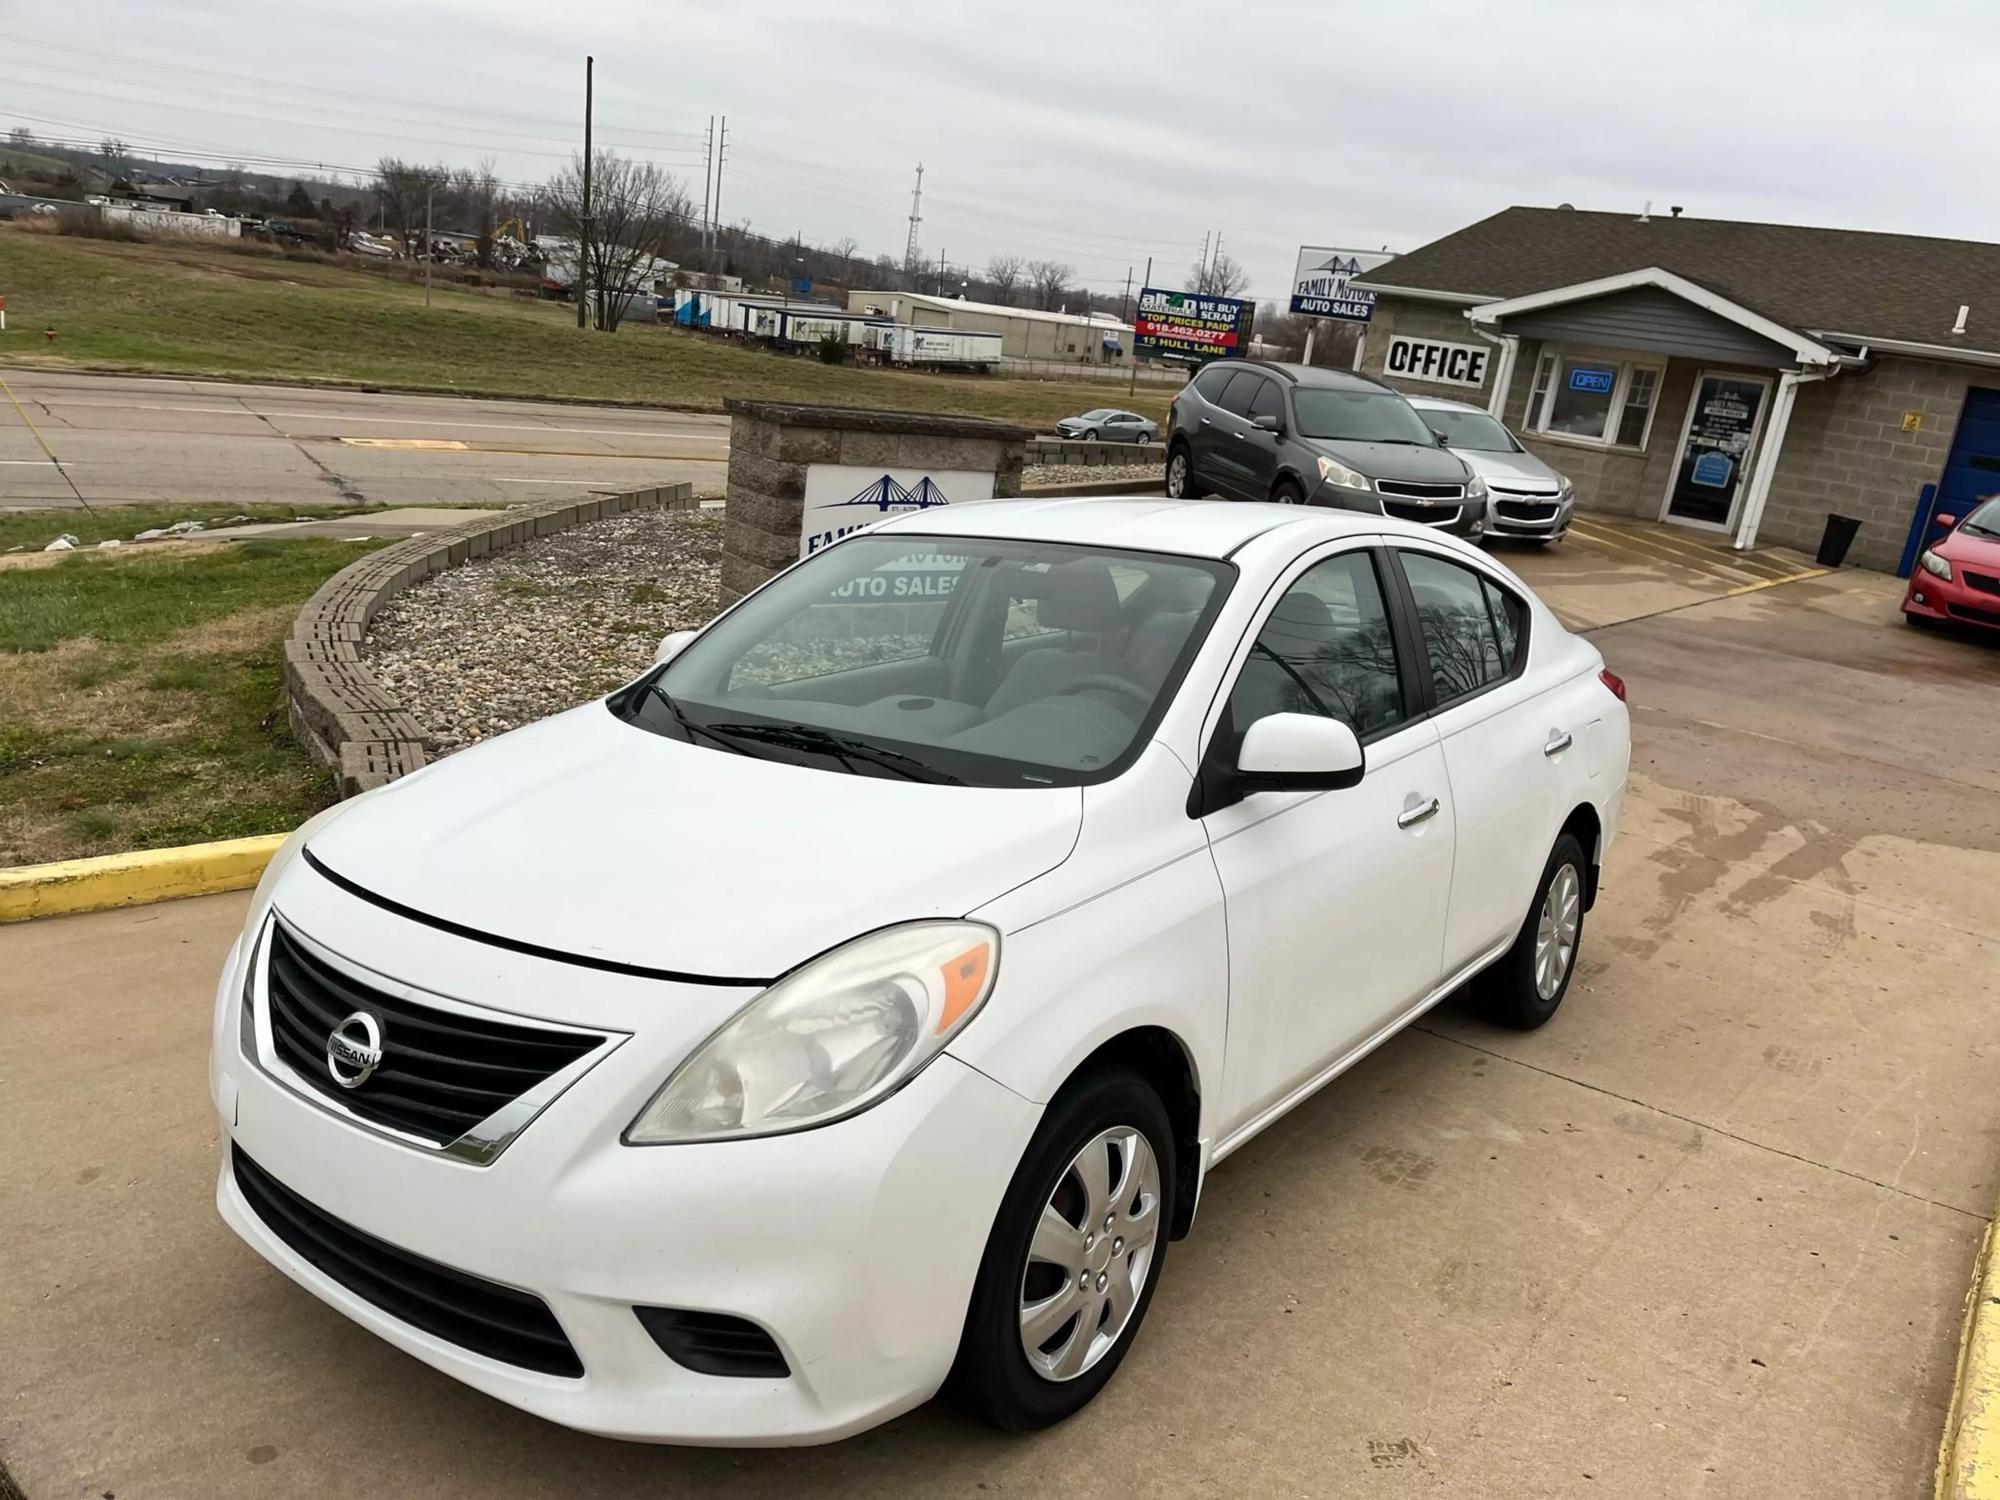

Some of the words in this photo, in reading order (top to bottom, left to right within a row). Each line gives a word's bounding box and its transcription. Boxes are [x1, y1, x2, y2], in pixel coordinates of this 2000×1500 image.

[1298, 278, 1335, 297] FAMILY
[1200, 301, 1215, 311] WE
[1218, 304, 1240, 314] BUY
[1201, 311, 1235, 322] SCRAP
[1300, 299, 1330, 312] AUTO
[1332, 302, 1368, 317] SALES
[1147, 322, 1226, 339] 618.462.0277
[1168, 316, 1204, 328] PRICES
[1143, 336, 1156, 345] 15
[1160, 339, 1191, 350] HULL
[1194, 344, 1226, 355] LANE
[1389, 341, 1486, 382] OFFICE
[1576, 375, 1608, 388] OPEN
[830, 577, 886, 597] UTO
[330, 1038, 370, 1065] NISSAN
